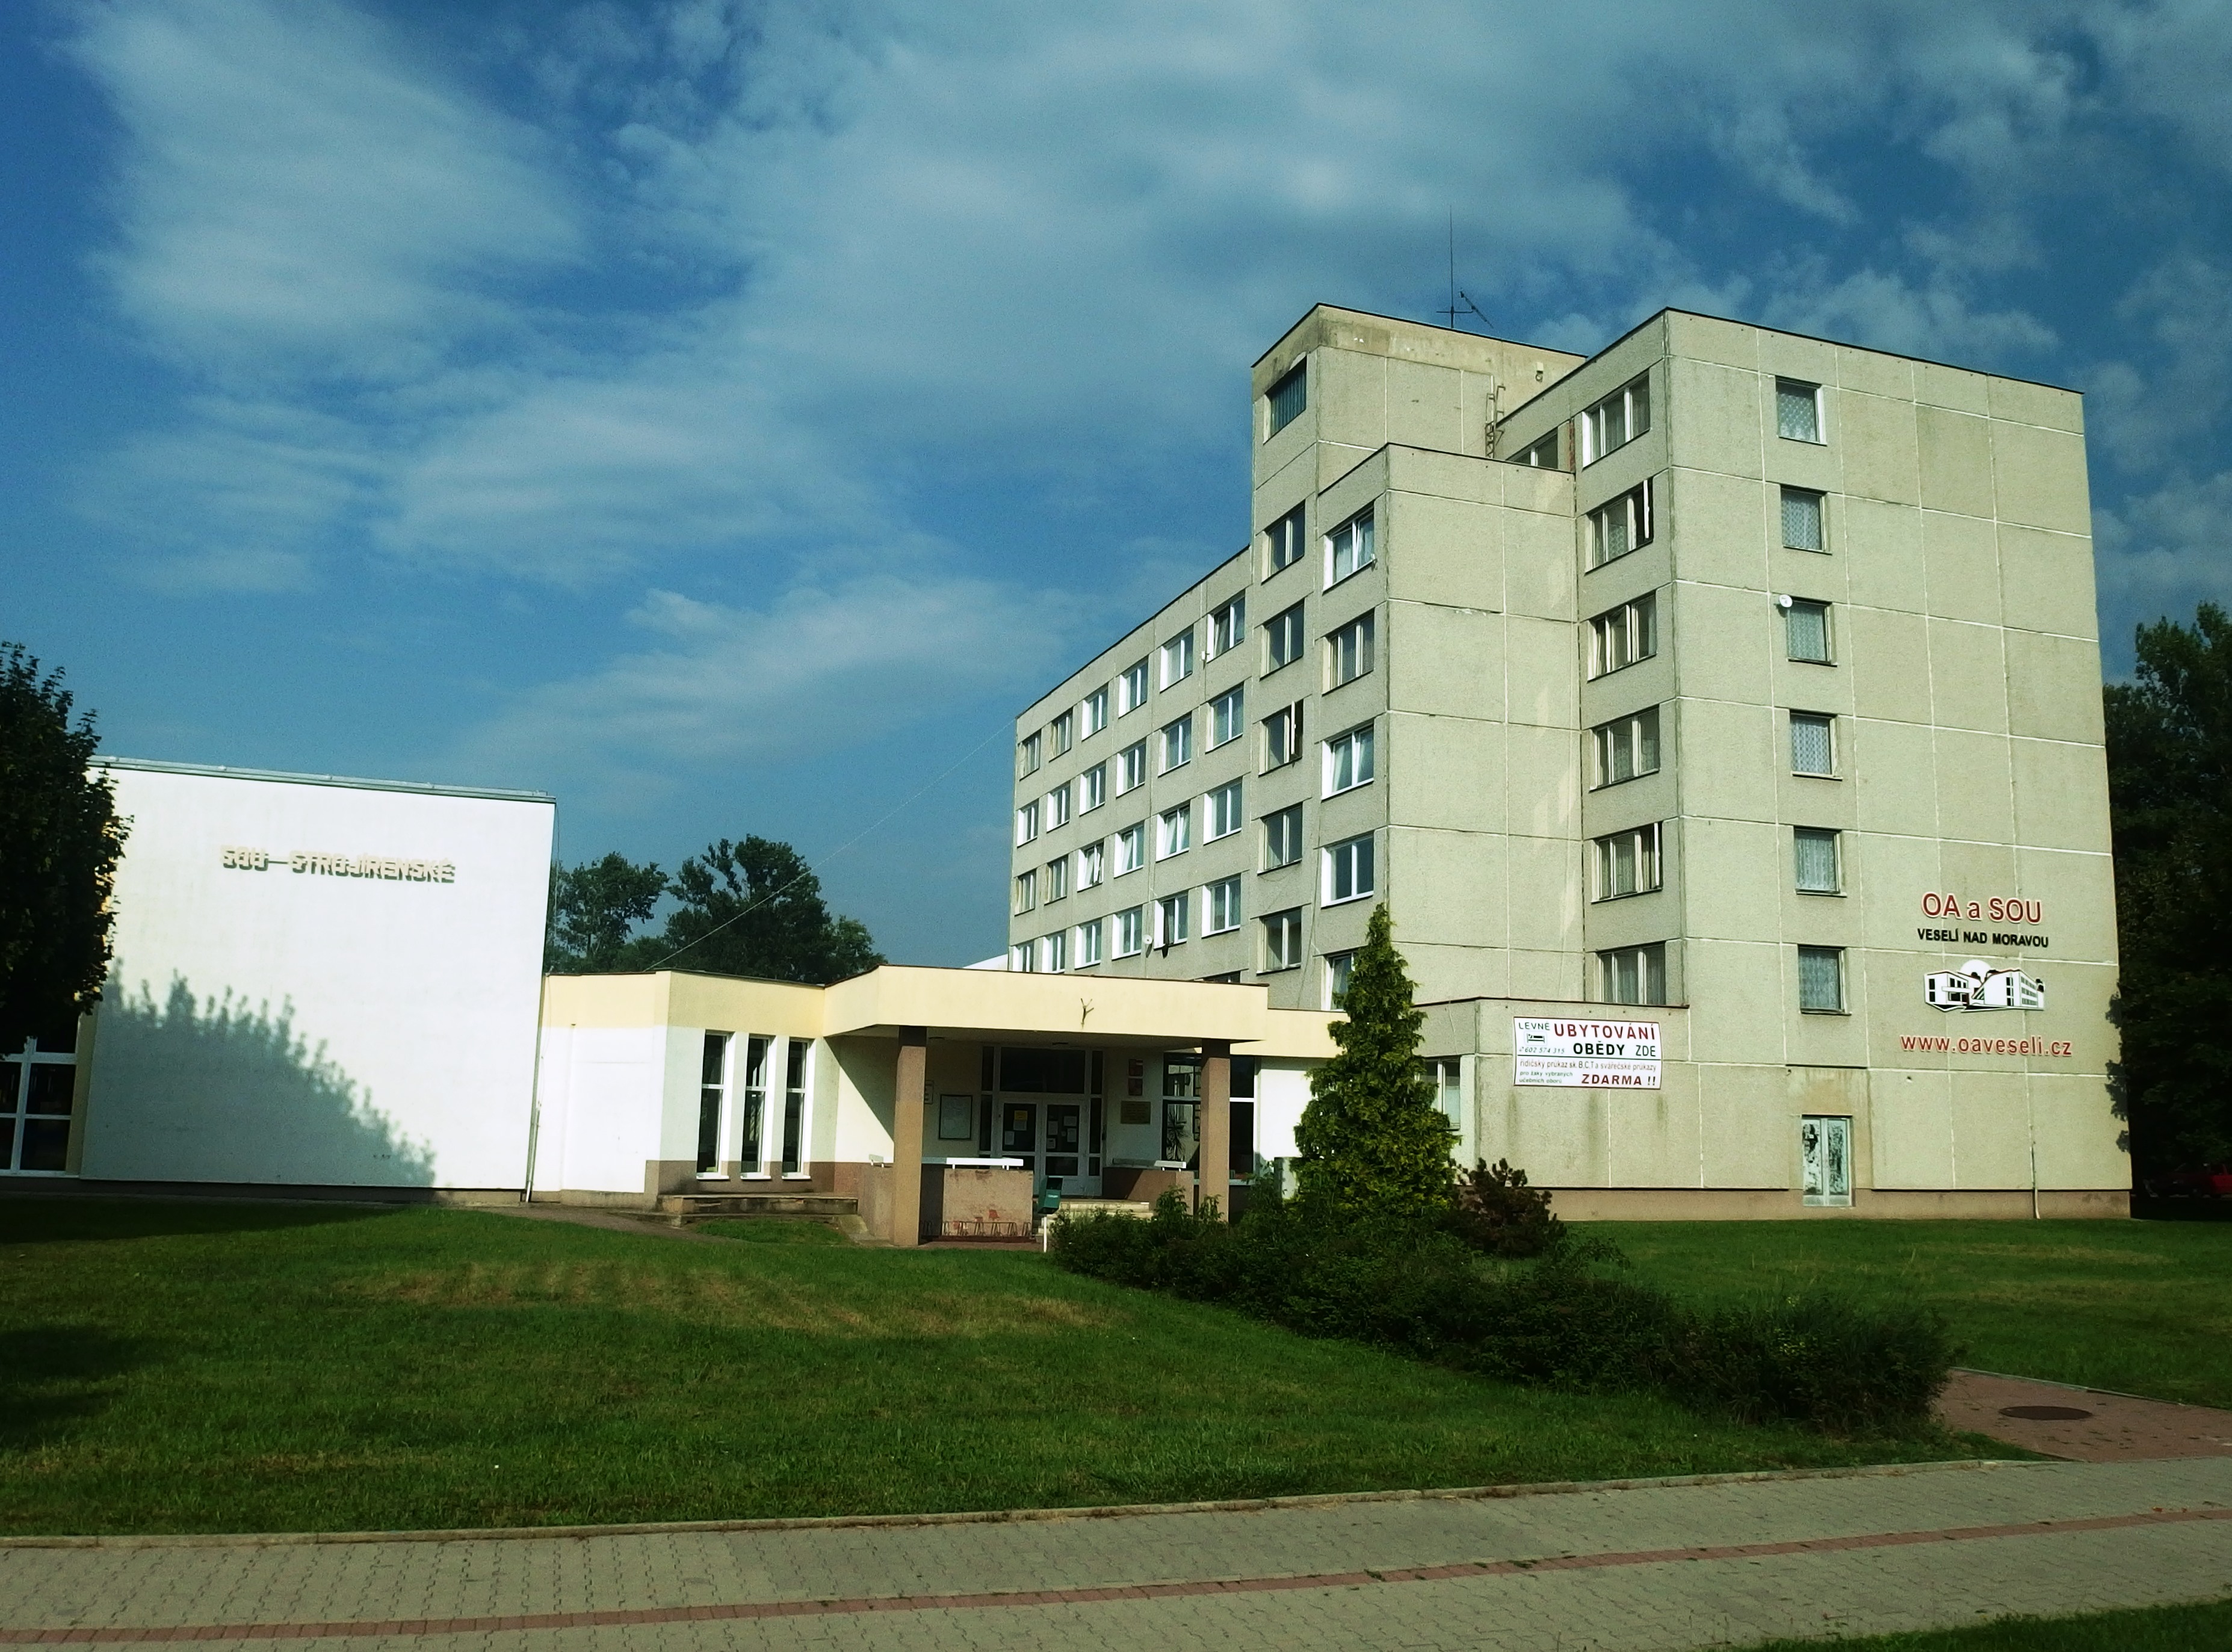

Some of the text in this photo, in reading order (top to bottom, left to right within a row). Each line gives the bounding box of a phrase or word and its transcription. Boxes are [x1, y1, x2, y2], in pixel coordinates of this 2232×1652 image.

[1922, 892, 2042, 924] OA a SOU
[1917, 928, 2049, 948] VESELÍ NAD MORAVOU
[1518, 1021, 1655, 1041] LEVNÉ UBYTOVÁNÍ
[1572, 1041, 1656, 1057] OBĚDY ZDE
[1900, 1035, 2072, 1056] www.oaveseli.cz
[1581, 1074, 1642, 1085] ZDARMA
